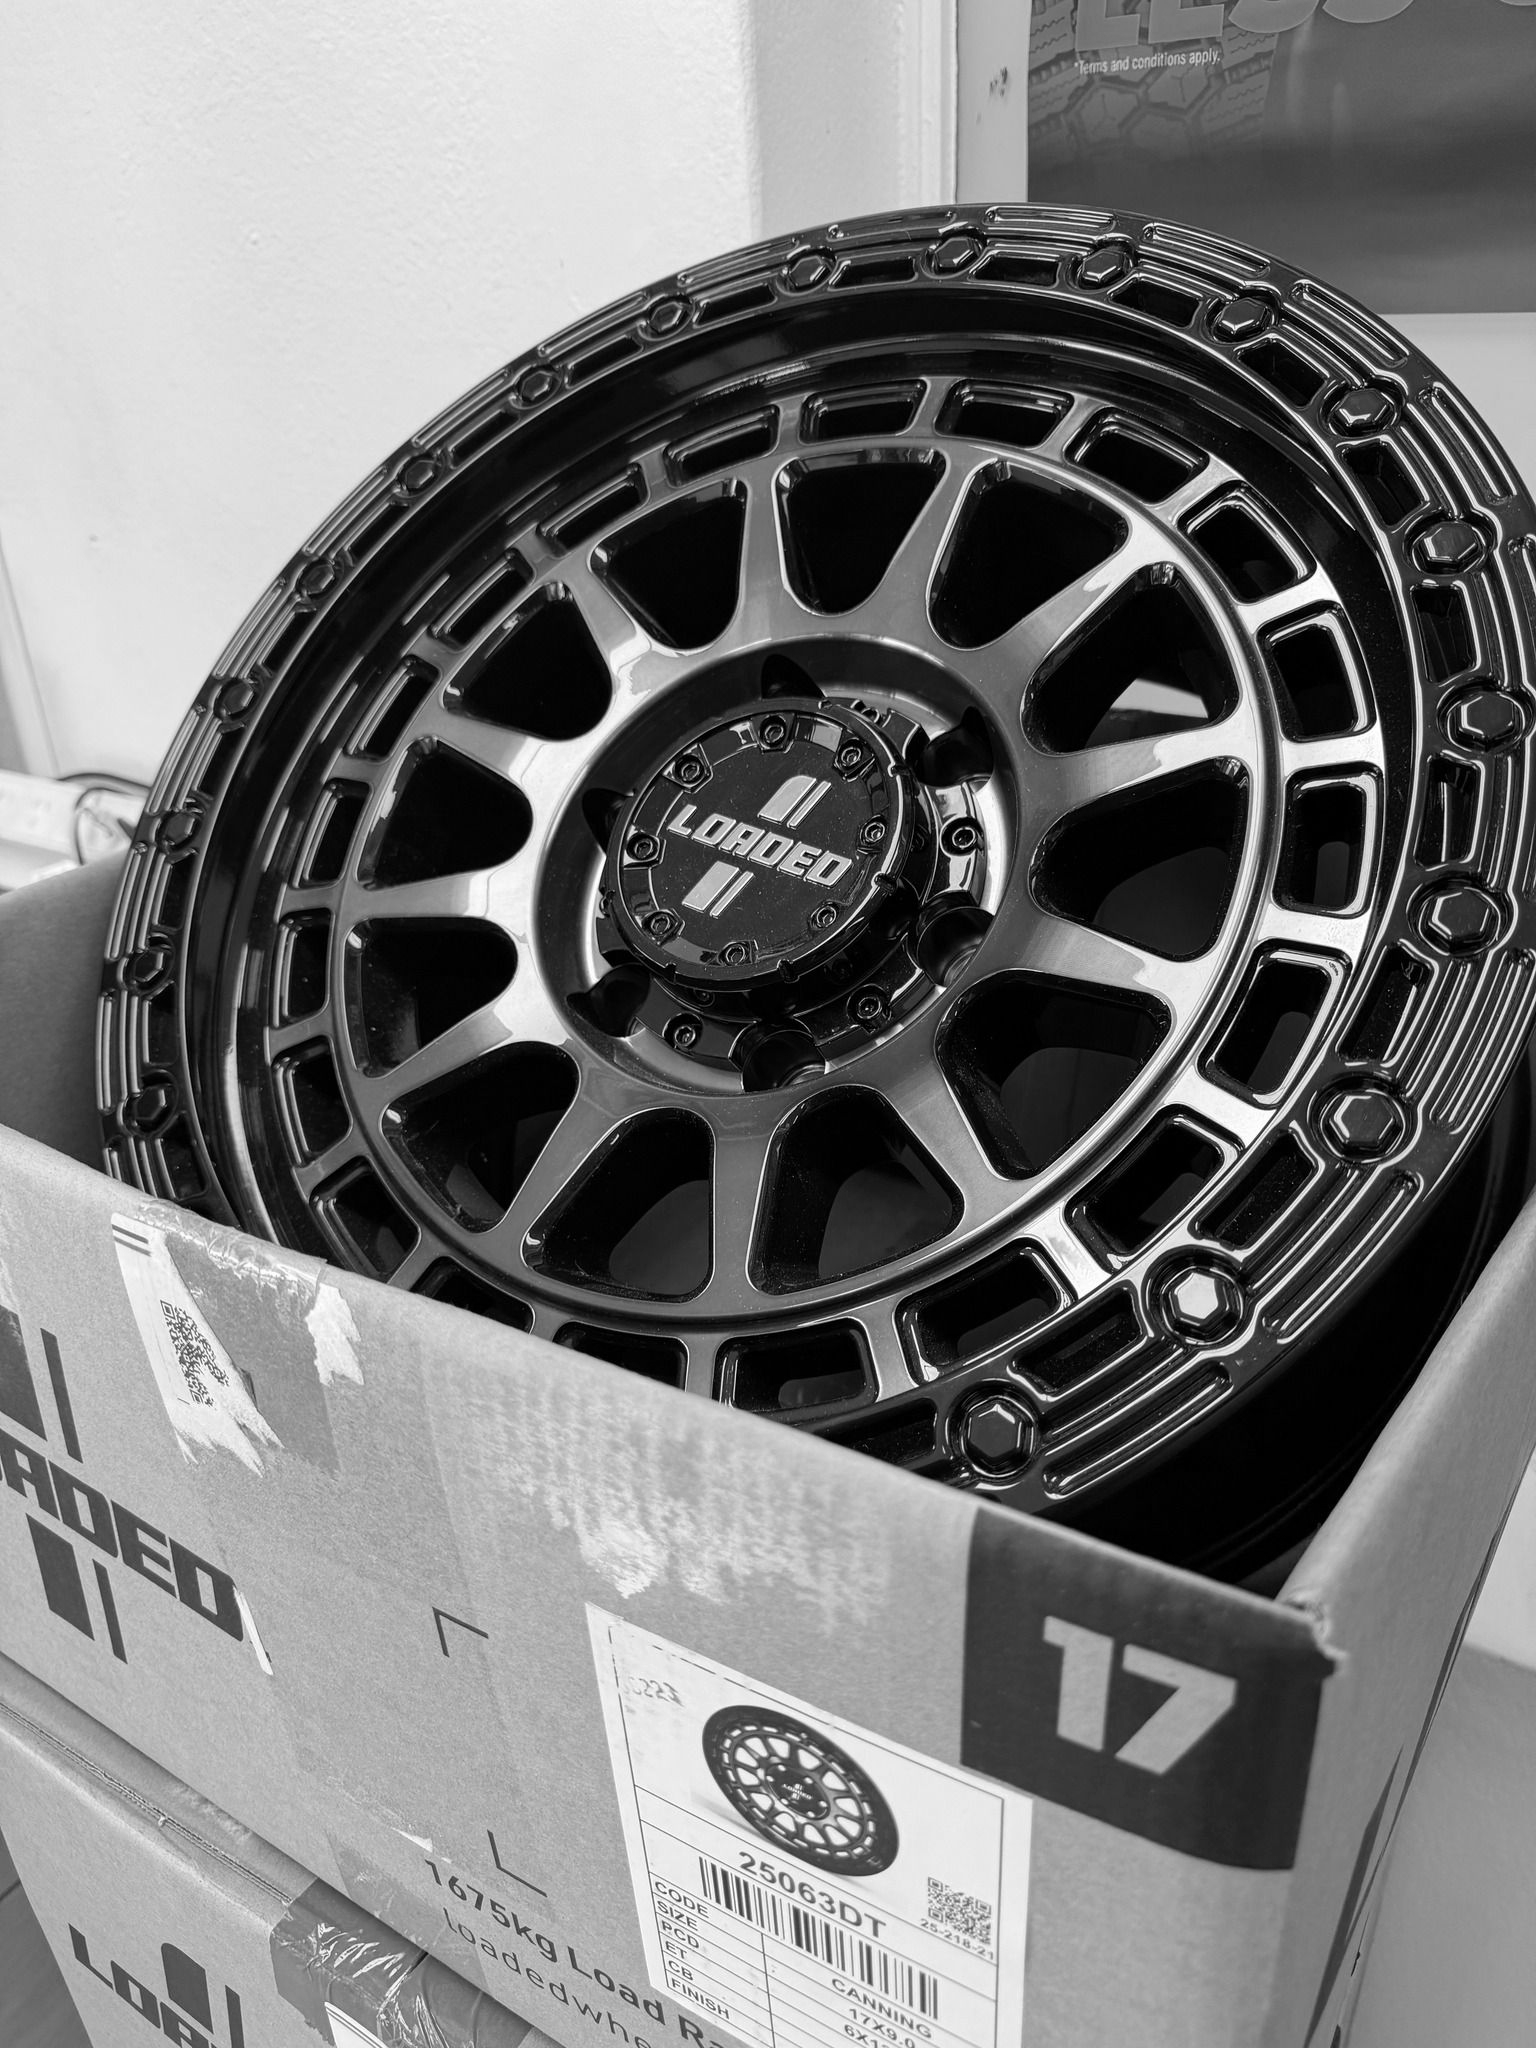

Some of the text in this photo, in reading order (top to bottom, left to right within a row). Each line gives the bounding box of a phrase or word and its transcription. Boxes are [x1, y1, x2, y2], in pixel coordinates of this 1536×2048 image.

[1110, 56, 1130, 72] and
[1132, 50, 1187, 71] conditions
[1189, 47, 1221, 67] apply.
[666, 804, 853, 889] LOADED
[1042, 1615, 1238, 1776] 17
[655, 1881, 710, 1919] CODE
[738, 1851, 887, 1938] 25063DT
[657, 1901, 698, 1931] SIZE
[661, 1920, 700, 1949] PCD
[424, 1858, 558, 1963] 1675kg
[567, 1945, 666, 2025] Load
[665, 1941, 687, 1960] ET
[668, 1960, 694, 1981] CB
[671, 1978, 730, 2020] FINISH
[832, 1978, 932, 2039] CANNING
